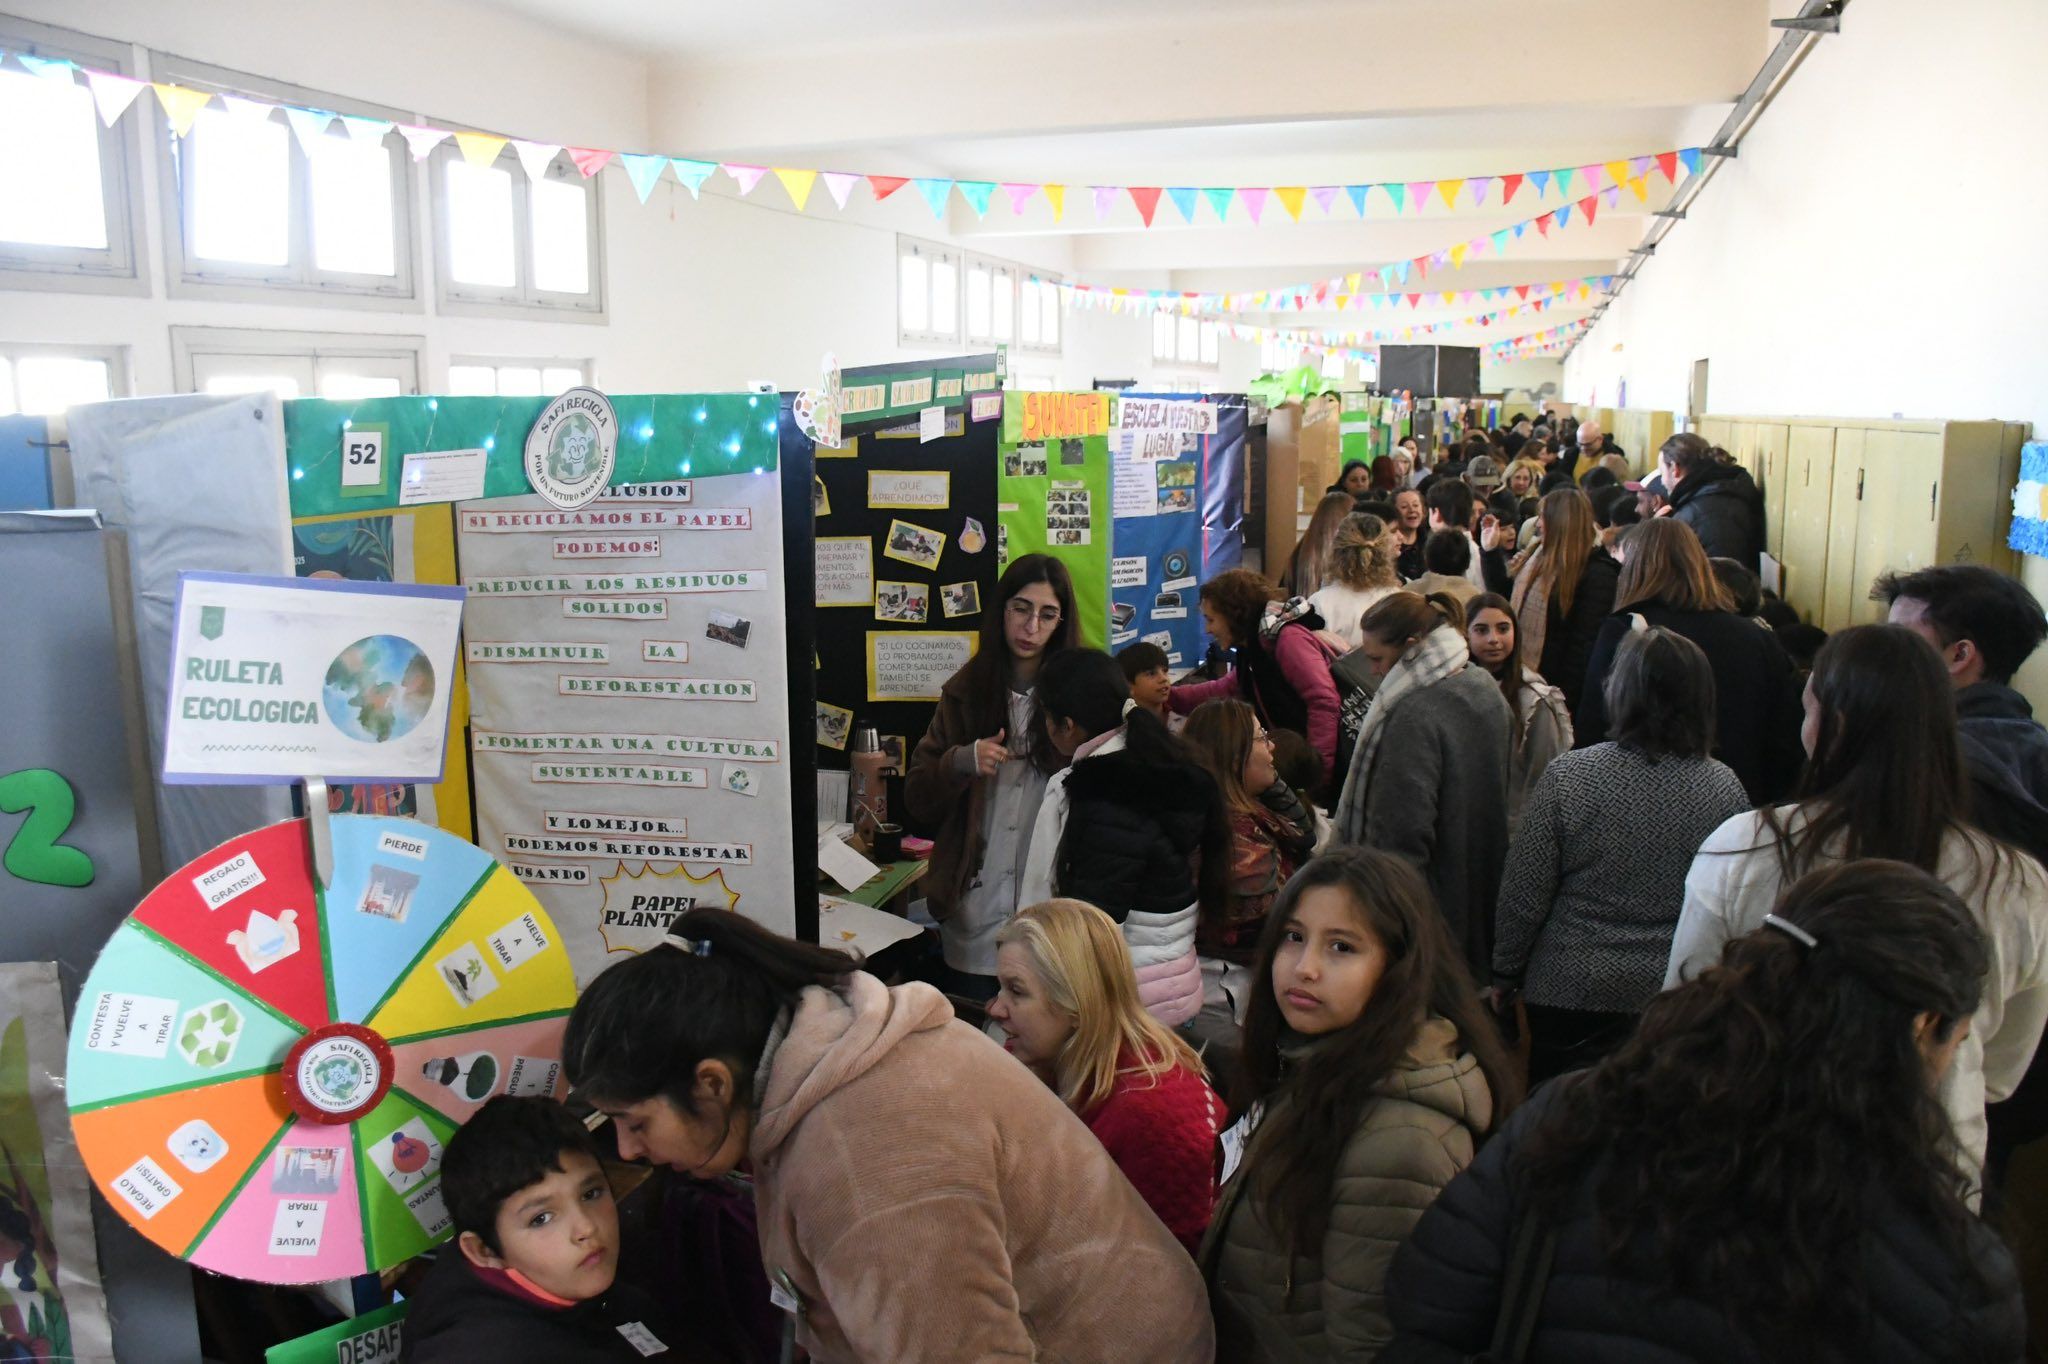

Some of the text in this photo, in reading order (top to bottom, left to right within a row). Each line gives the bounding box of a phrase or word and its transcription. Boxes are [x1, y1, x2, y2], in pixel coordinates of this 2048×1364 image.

[349, 443, 377, 465] 52
[548, 487, 580, 502] FUTURO
[872, 493, 945, 504] APRENDIMOS?
[469, 512, 747, 528] SI RECICLAMOS EL PAPEL
[556, 541, 658, 554] PODEMOS:
[477, 573, 748, 593] REDUCIR LOS RESIDUOS
[571, 602, 663, 614] SOLIDOS
[482, 645, 677, 659] DISMINUIR LA
[890, 641, 904, 650] LO
[879, 652, 891, 661] LO
[186, 656, 284, 685] RULETA
[878, 663, 912, 672] COMER
[920, 673, 931, 682] SE
[567, 679, 753, 696] DEFORESTACION
[182, 696, 319, 724] ECOLOGICA
[487, 735, 776, 757] FOMENTAR UNA CULTURA
[539, 765, 694, 783] SUSTENTABLE
[548, 816, 559, 828] Y
[384, 837, 424, 854] PIERDE
[507, 837, 749, 860] PODEMOS REFORESTAR
[202, 857, 246, 887] REGALO
[512, 865, 586, 881] USANDO
[211, 872, 260, 904] GRATIS!!!
[523, 914, 546, 948] VUELVE
[513, 938, 522, 946] A
[493, 937, 513, 965] TIRAR
[88, 992, 113, 1048] CONTESTA
[110, 999, 134, 1048] Y VUELVE
[139, 1023, 149, 1031] A
[155, 1014, 173, 1045] TIRAR
[135, 1164, 171, 1197] GRATIS!!
[119, 1178, 154, 1211] REGALO
[287, 1202, 319, 1212] TIRAR
[296, 1219, 304, 1229] A
[276, 1237, 317, 1247] VUELVE
